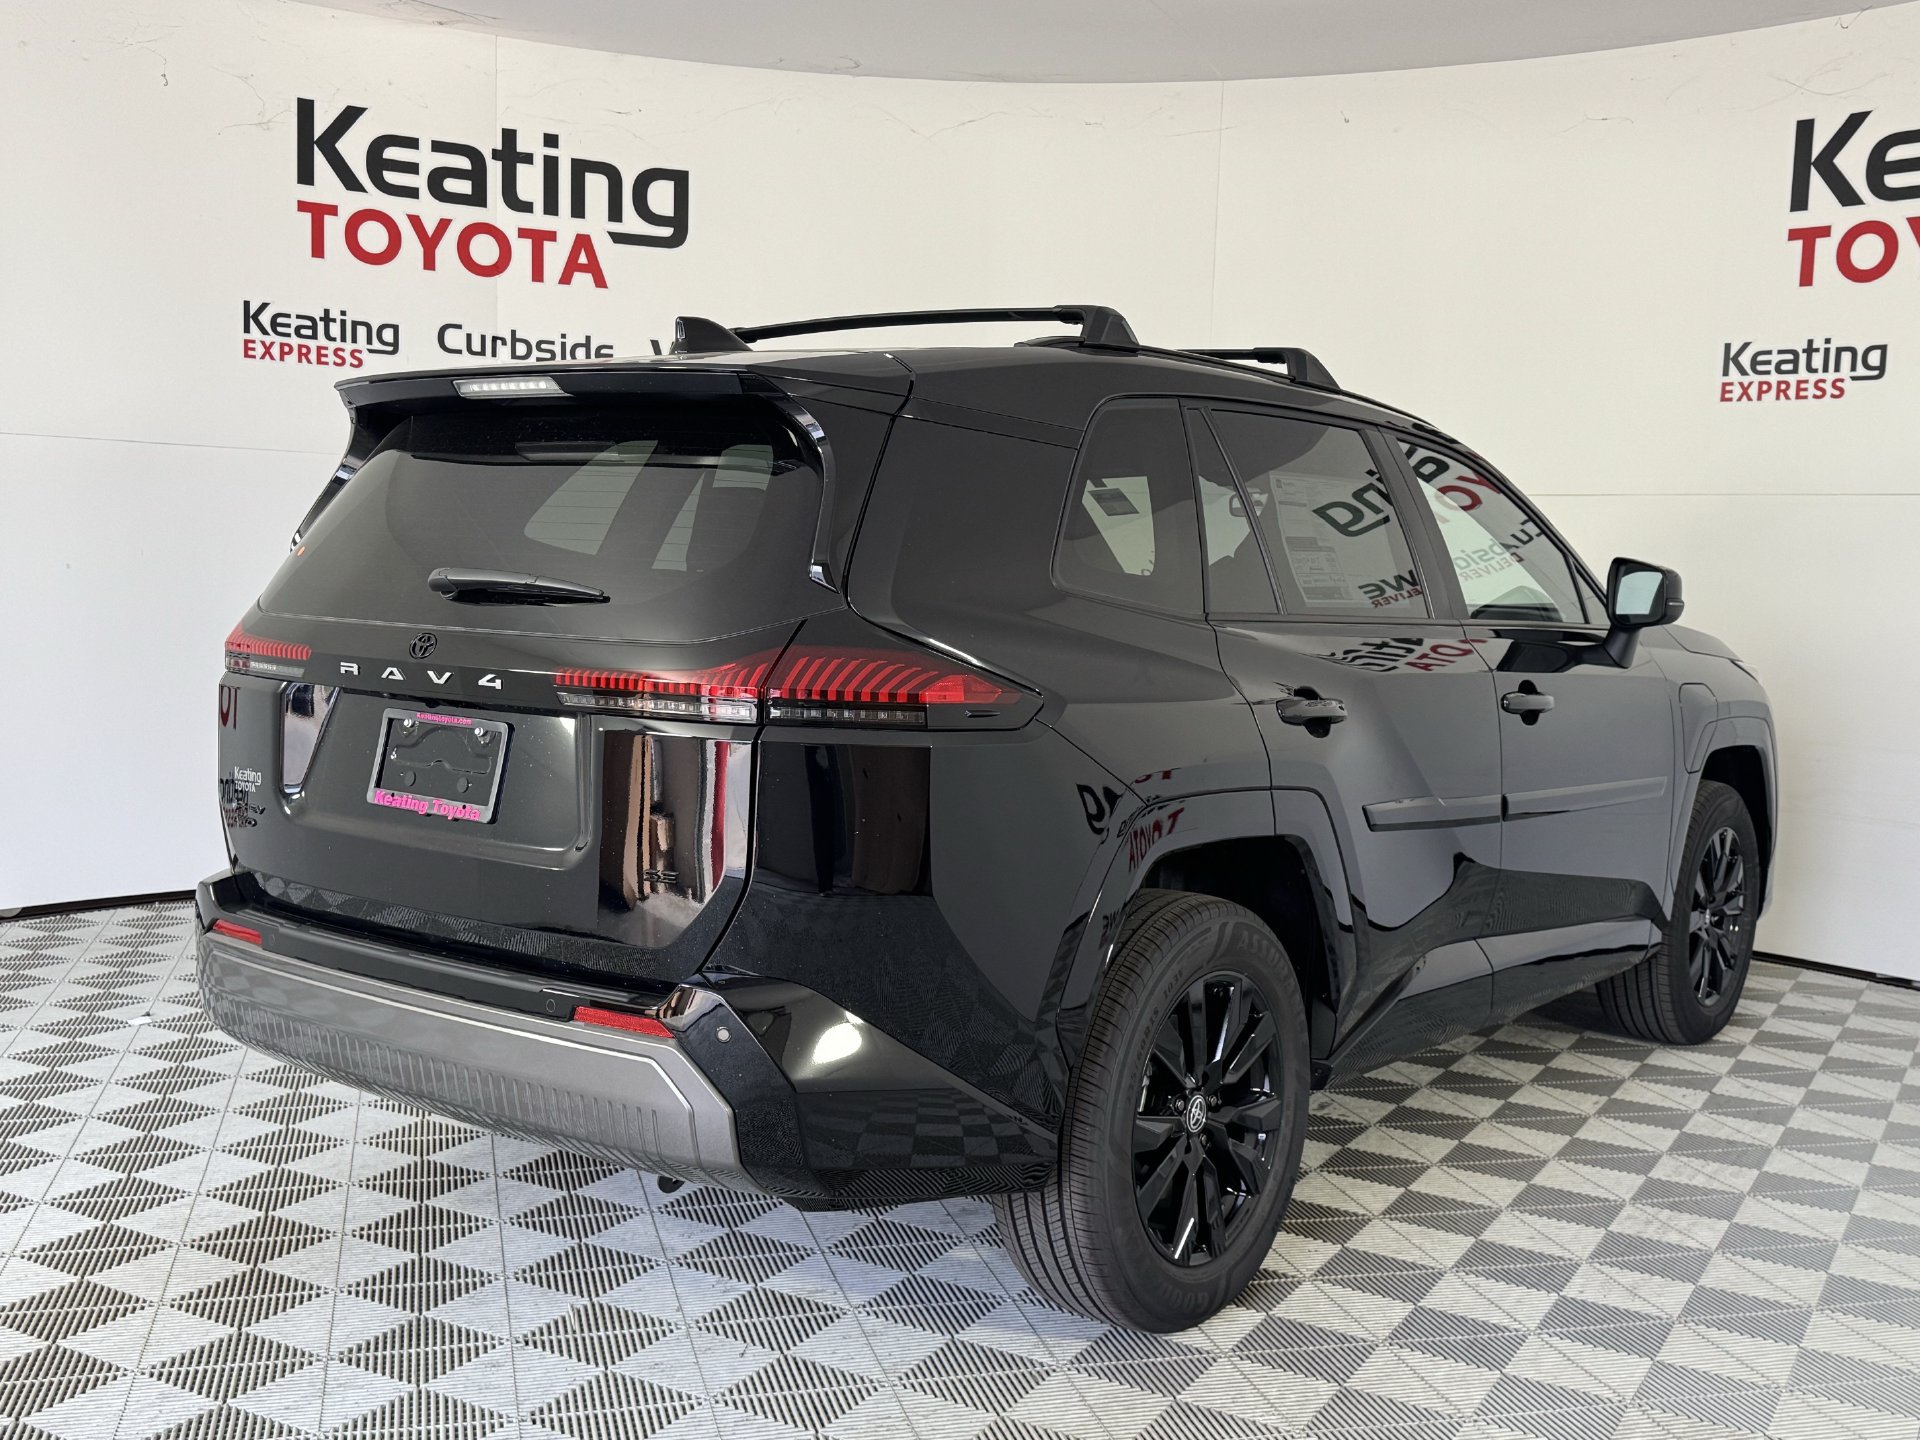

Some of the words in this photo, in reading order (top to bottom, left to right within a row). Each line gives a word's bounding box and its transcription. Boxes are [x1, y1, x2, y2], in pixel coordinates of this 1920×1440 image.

[297, 97, 690, 249] Keating
[297, 200, 608, 289] TOYOTA
[243, 300, 400, 355] Keating
[438, 323, 614, 361] Curbside
[243, 338, 364, 368] EXPRESS
[1722, 338, 1888, 381] Keating
[1720, 378, 1846, 402] EXPRESS
[340, 661, 504, 690] RAV4
[234, 766, 262, 785] Keating
[235, 780, 256, 792] TOYOTA
[374, 790, 429, 814] Keating
[432, 799, 481, 820] Toyota
